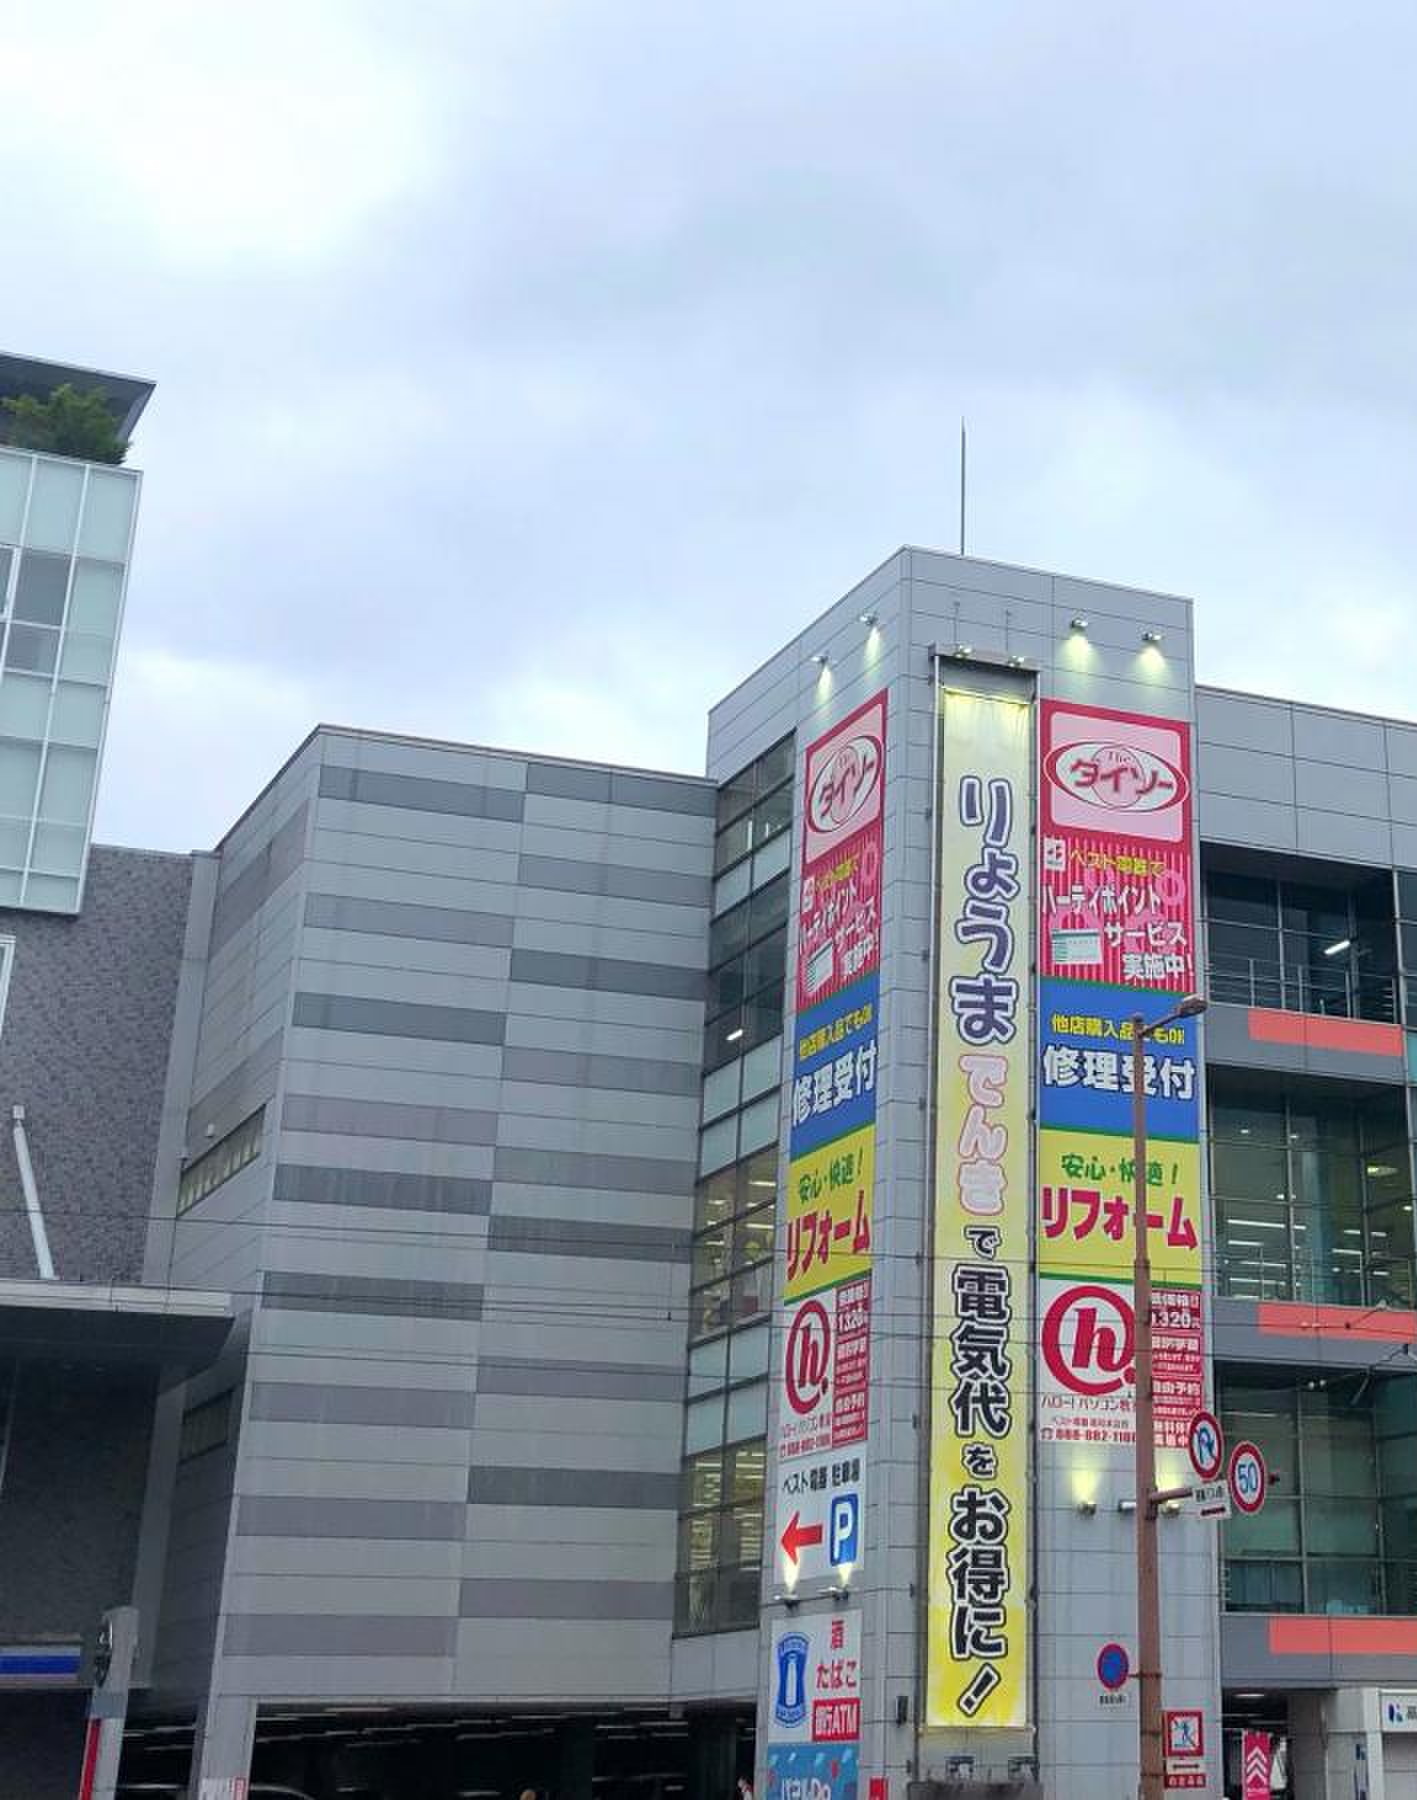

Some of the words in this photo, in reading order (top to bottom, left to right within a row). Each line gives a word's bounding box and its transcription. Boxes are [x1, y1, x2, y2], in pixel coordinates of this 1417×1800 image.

[1070, 760, 1174, 795] ダイソー
[1104, 921, 1187, 947] サービス
[792, 1039, 878, 1126] 修理受付
[1043, 1045, 1195, 1100] 修理受付
[787, 1189, 871, 1280] リフォーム
[1042, 1187, 1198, 1250] リフォーム
[1237, 1462, 1259, 1494] 50
[832, 1502, 853, 1560] P
[816, 1660, 858, 1689] たばこ
